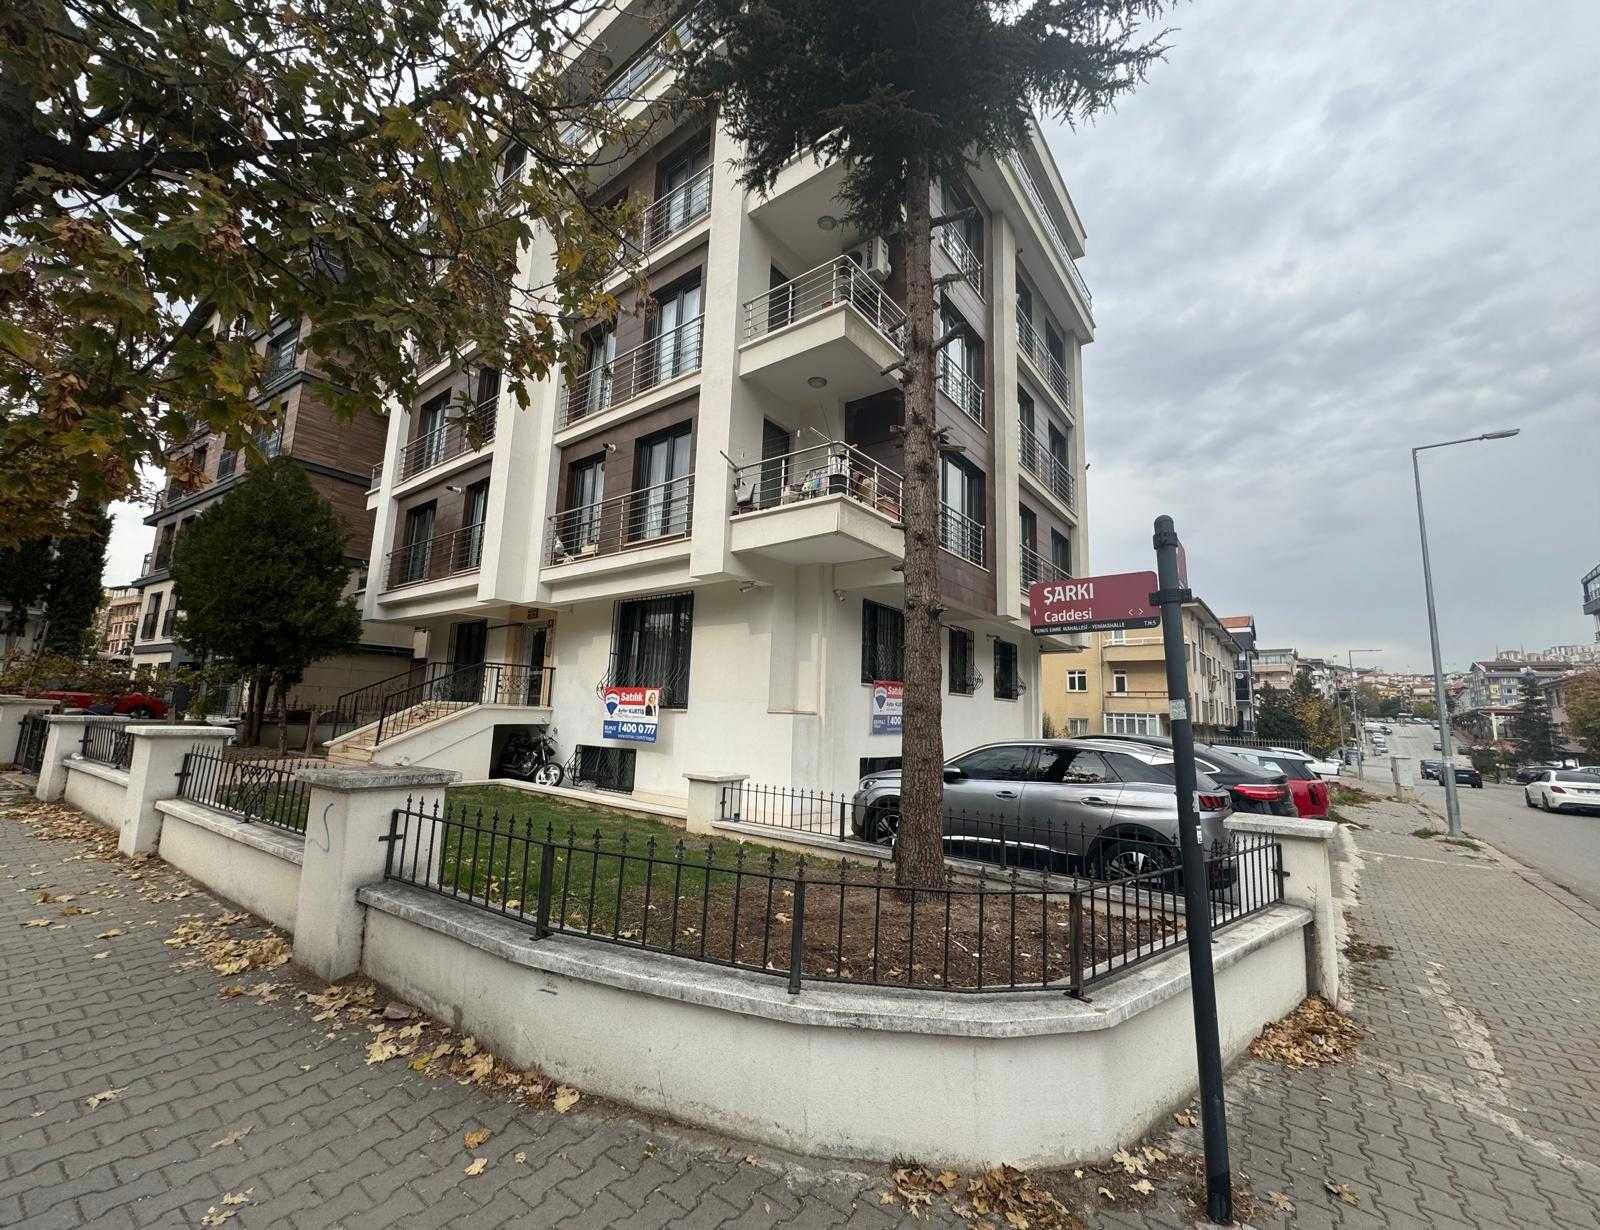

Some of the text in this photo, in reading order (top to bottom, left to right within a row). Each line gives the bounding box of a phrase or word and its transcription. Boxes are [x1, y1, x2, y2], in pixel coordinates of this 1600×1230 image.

[1043, 583, 1094, 605] ŞARKI
[1044, 608, 1092, 623] Caddesi
[622, 723, 637, 733] 400
[644, 725, 656, 735] 777
